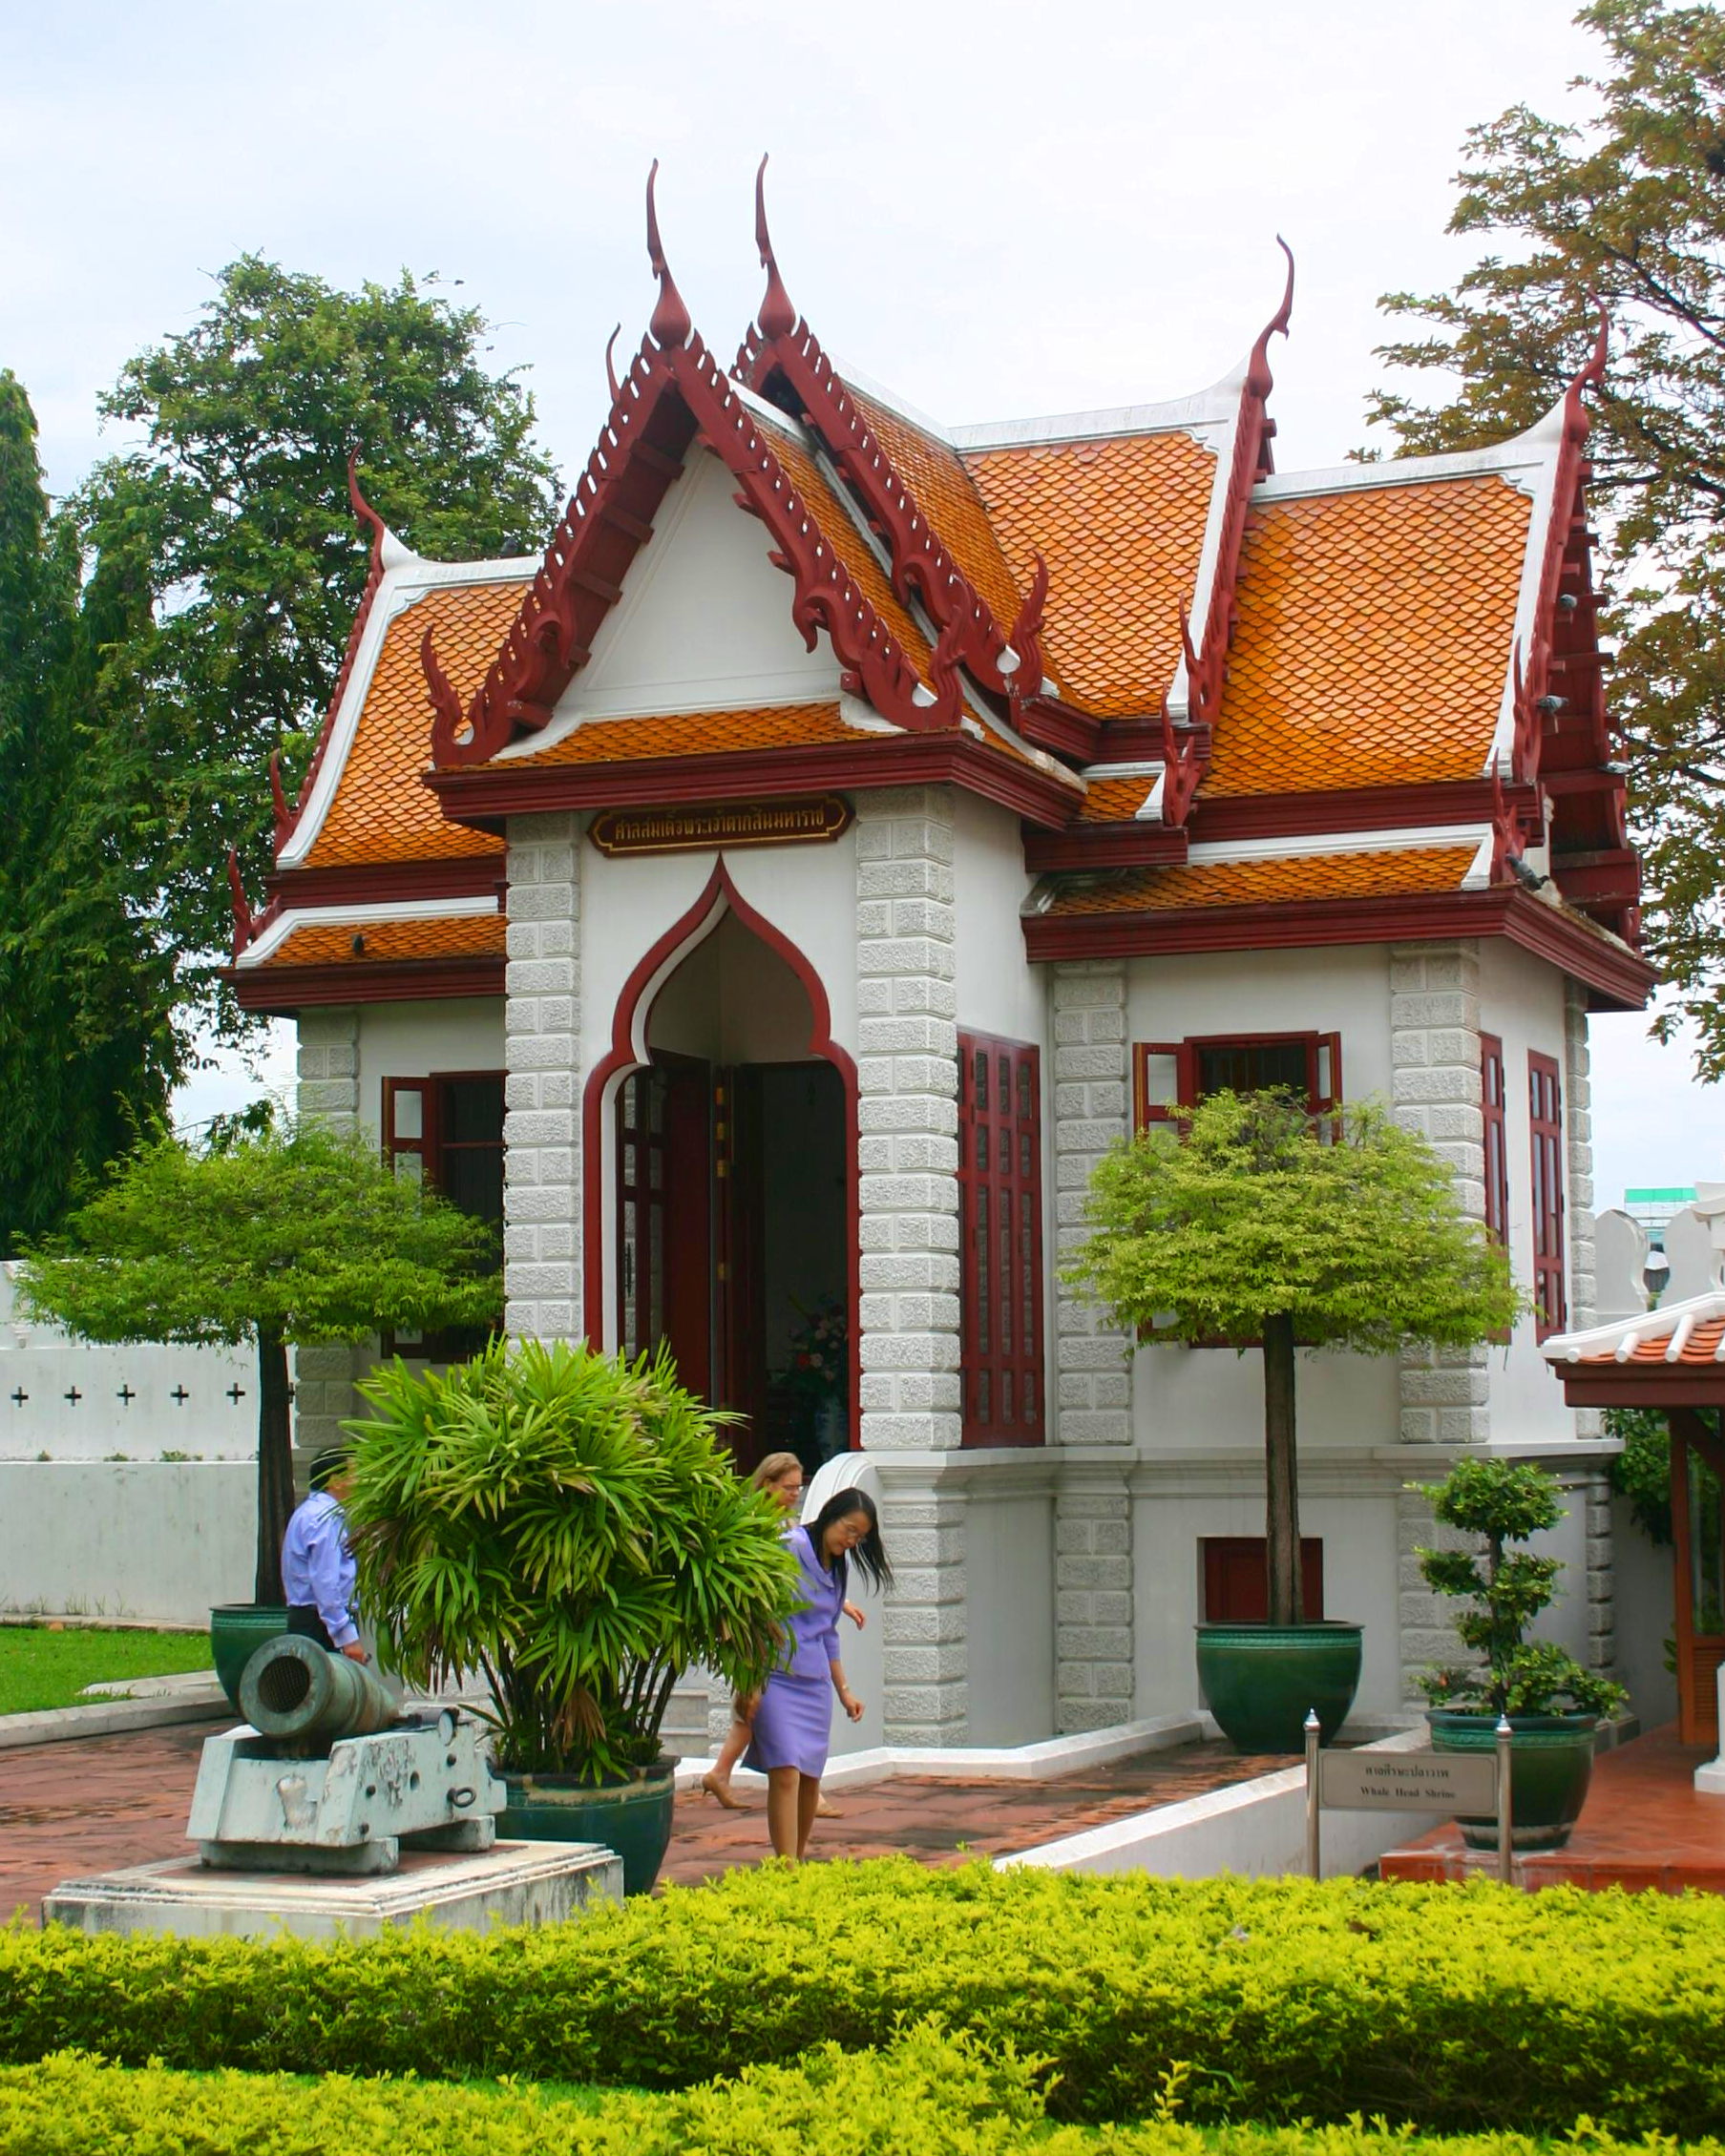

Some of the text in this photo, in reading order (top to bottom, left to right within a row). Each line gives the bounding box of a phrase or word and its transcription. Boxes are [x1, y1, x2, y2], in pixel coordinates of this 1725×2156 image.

[1360, 1787, 1456, 1799] Whale Head Shrine
